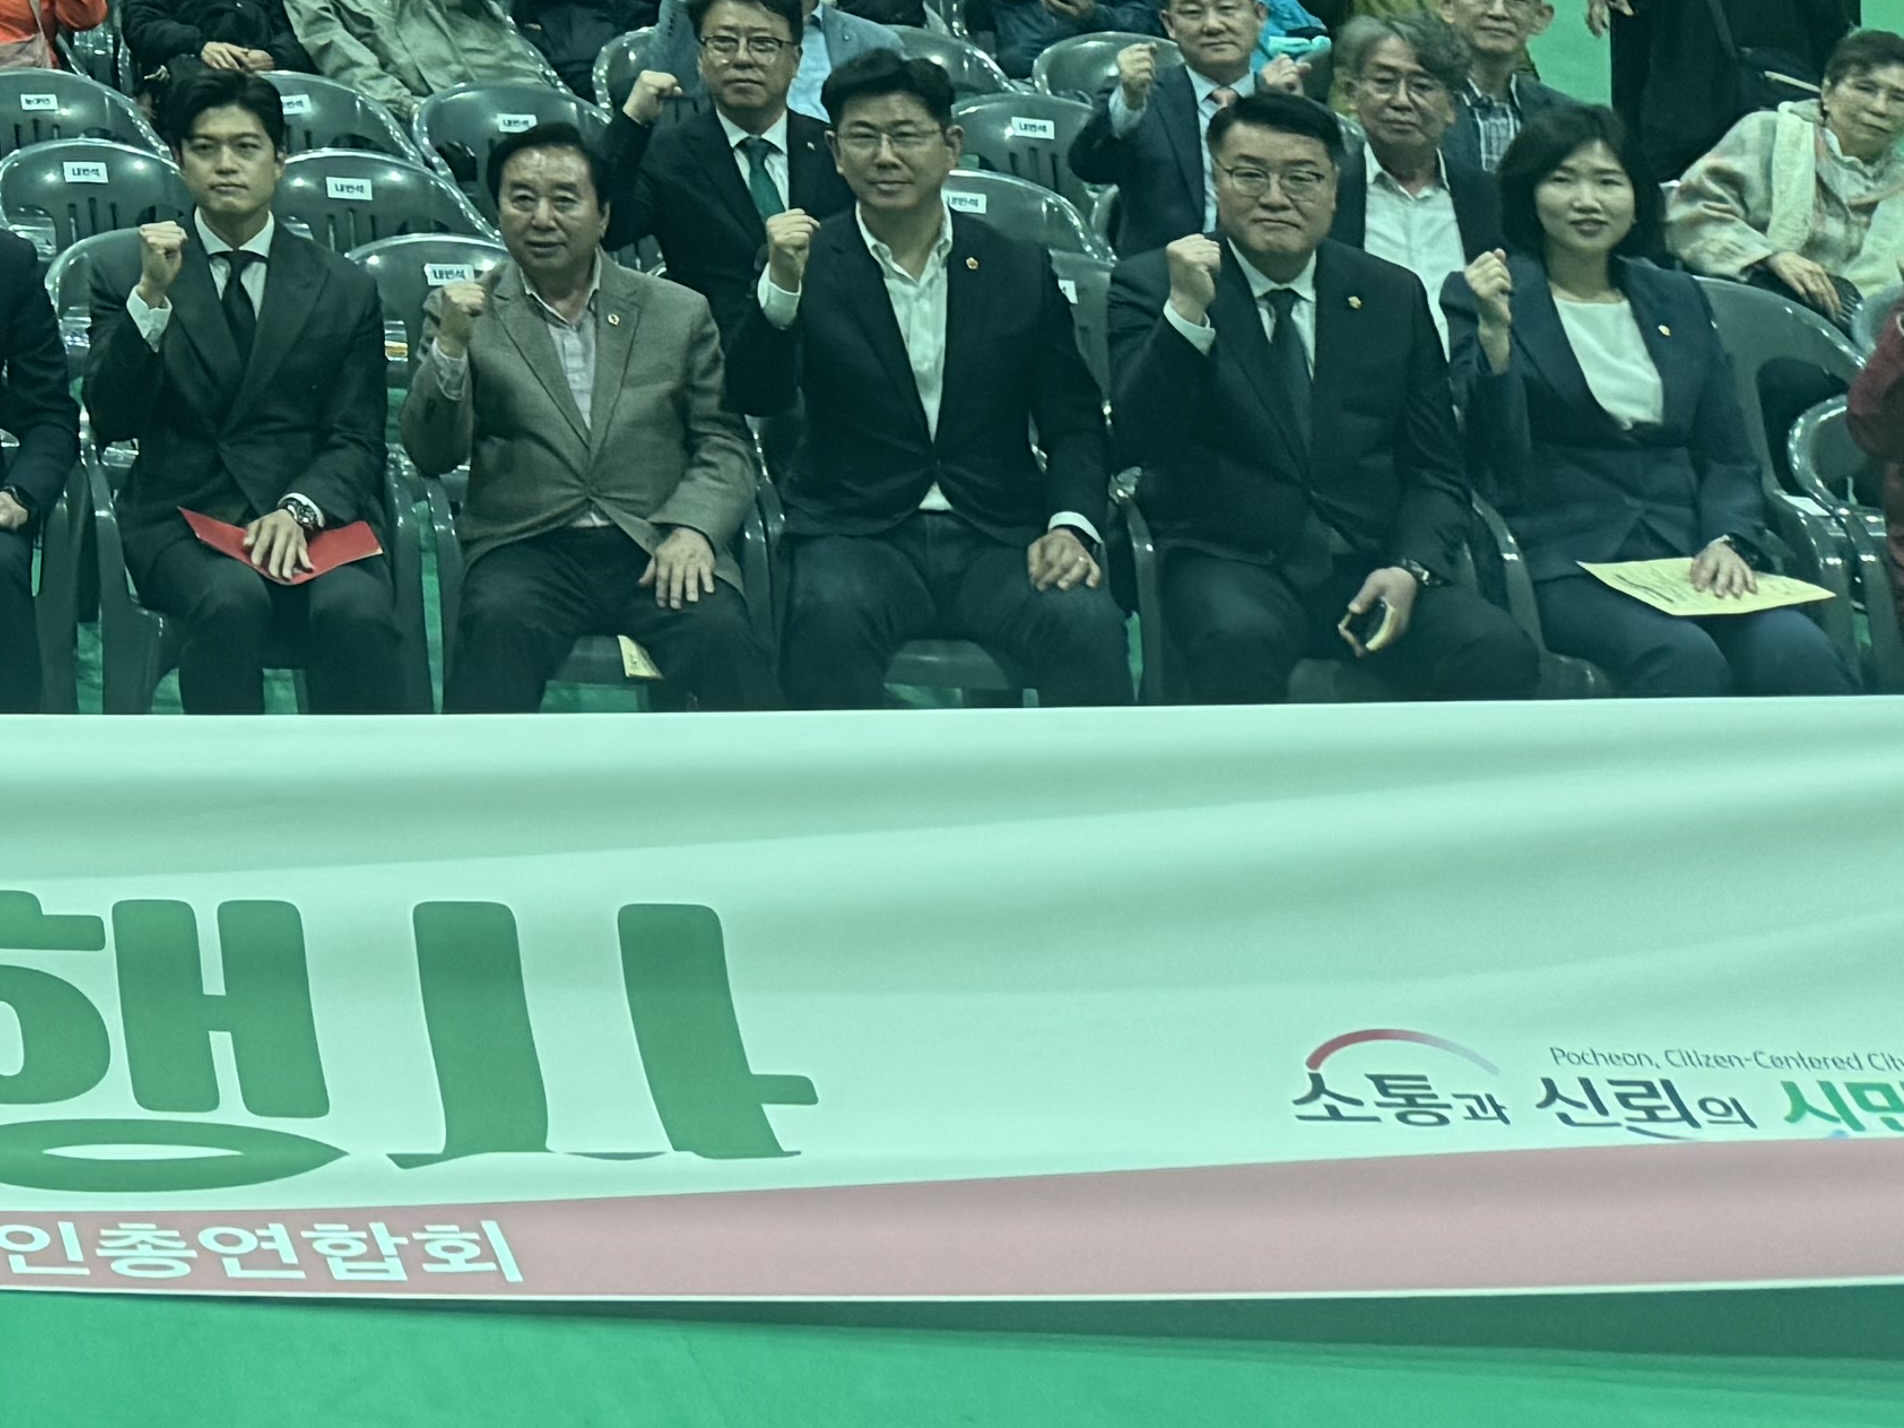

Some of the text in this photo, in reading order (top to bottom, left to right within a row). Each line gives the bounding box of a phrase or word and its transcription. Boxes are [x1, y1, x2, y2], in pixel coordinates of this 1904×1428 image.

[1549, 1046, 1662, 1070] Pocheon,
[1664, 1048, 1864, 1072] Citizen-Centered
[1292, 1072, 1511, 1127] 소통과
[1535, 1076, 1759, 1131] 신뢰의
